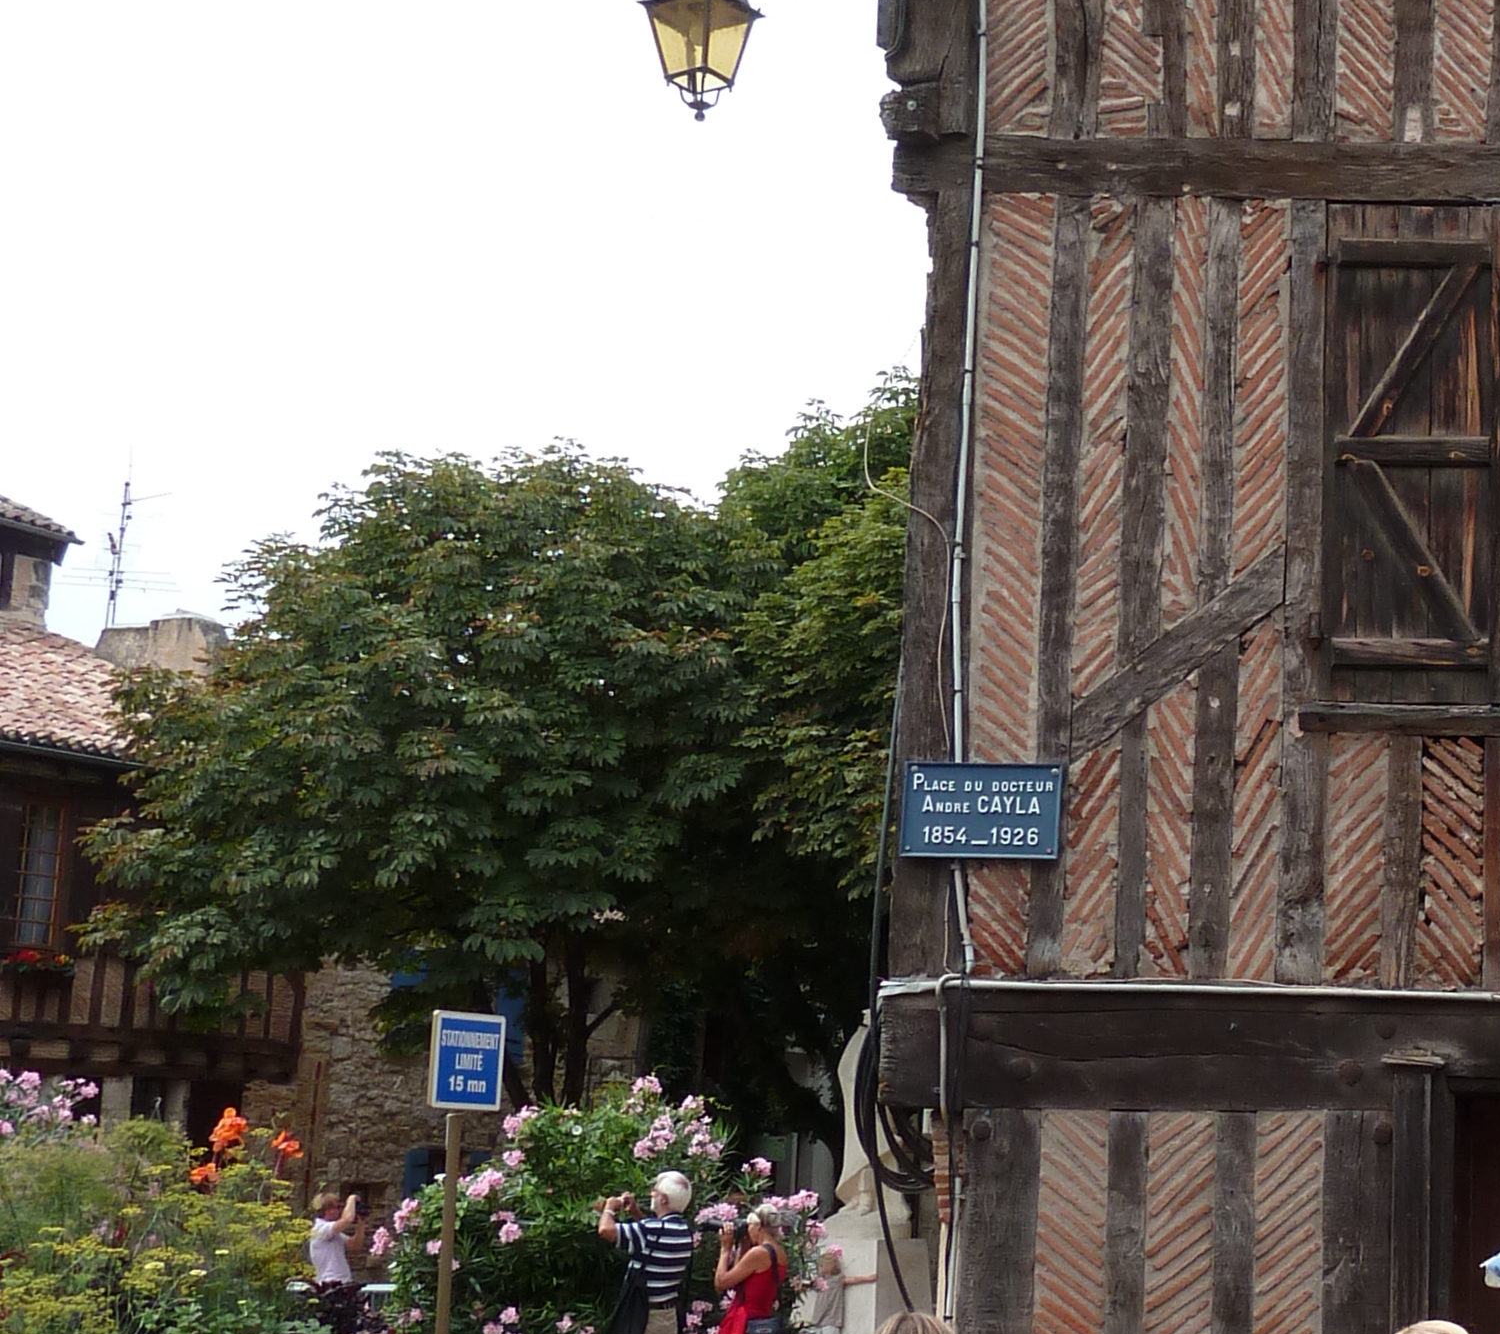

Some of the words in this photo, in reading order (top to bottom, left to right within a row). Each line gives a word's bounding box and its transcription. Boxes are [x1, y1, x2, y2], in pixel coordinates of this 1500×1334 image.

[913, 773, 956, 791] PLACE
[964, 780, 983, 792] DU
[992, 780, 1054, 792] DOCTEUR
[977, 795, 1041, 815] CAYLA
[441, 1029, 500, 1050] STATIONNEMENT
[455, 1051, 484, 1071] LIMITÉ
[448, 1075, 464, 1092] 15
[467, 1079, 487, 1093] mn
